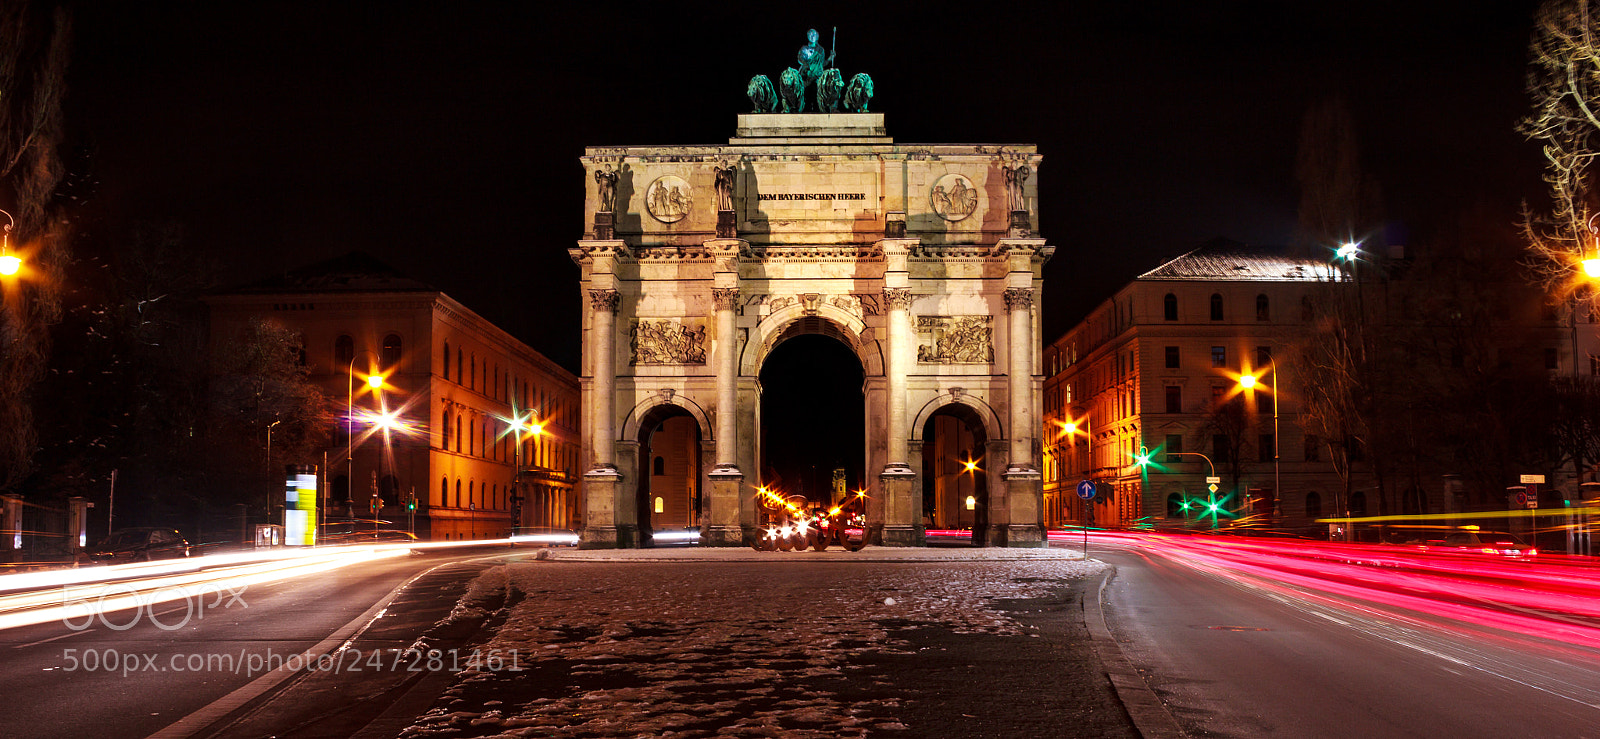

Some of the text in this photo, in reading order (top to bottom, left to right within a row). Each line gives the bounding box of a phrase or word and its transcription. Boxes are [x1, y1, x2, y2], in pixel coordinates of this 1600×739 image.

[757, 193, 866, 201] DEM BAYERISCHEN HEERE
